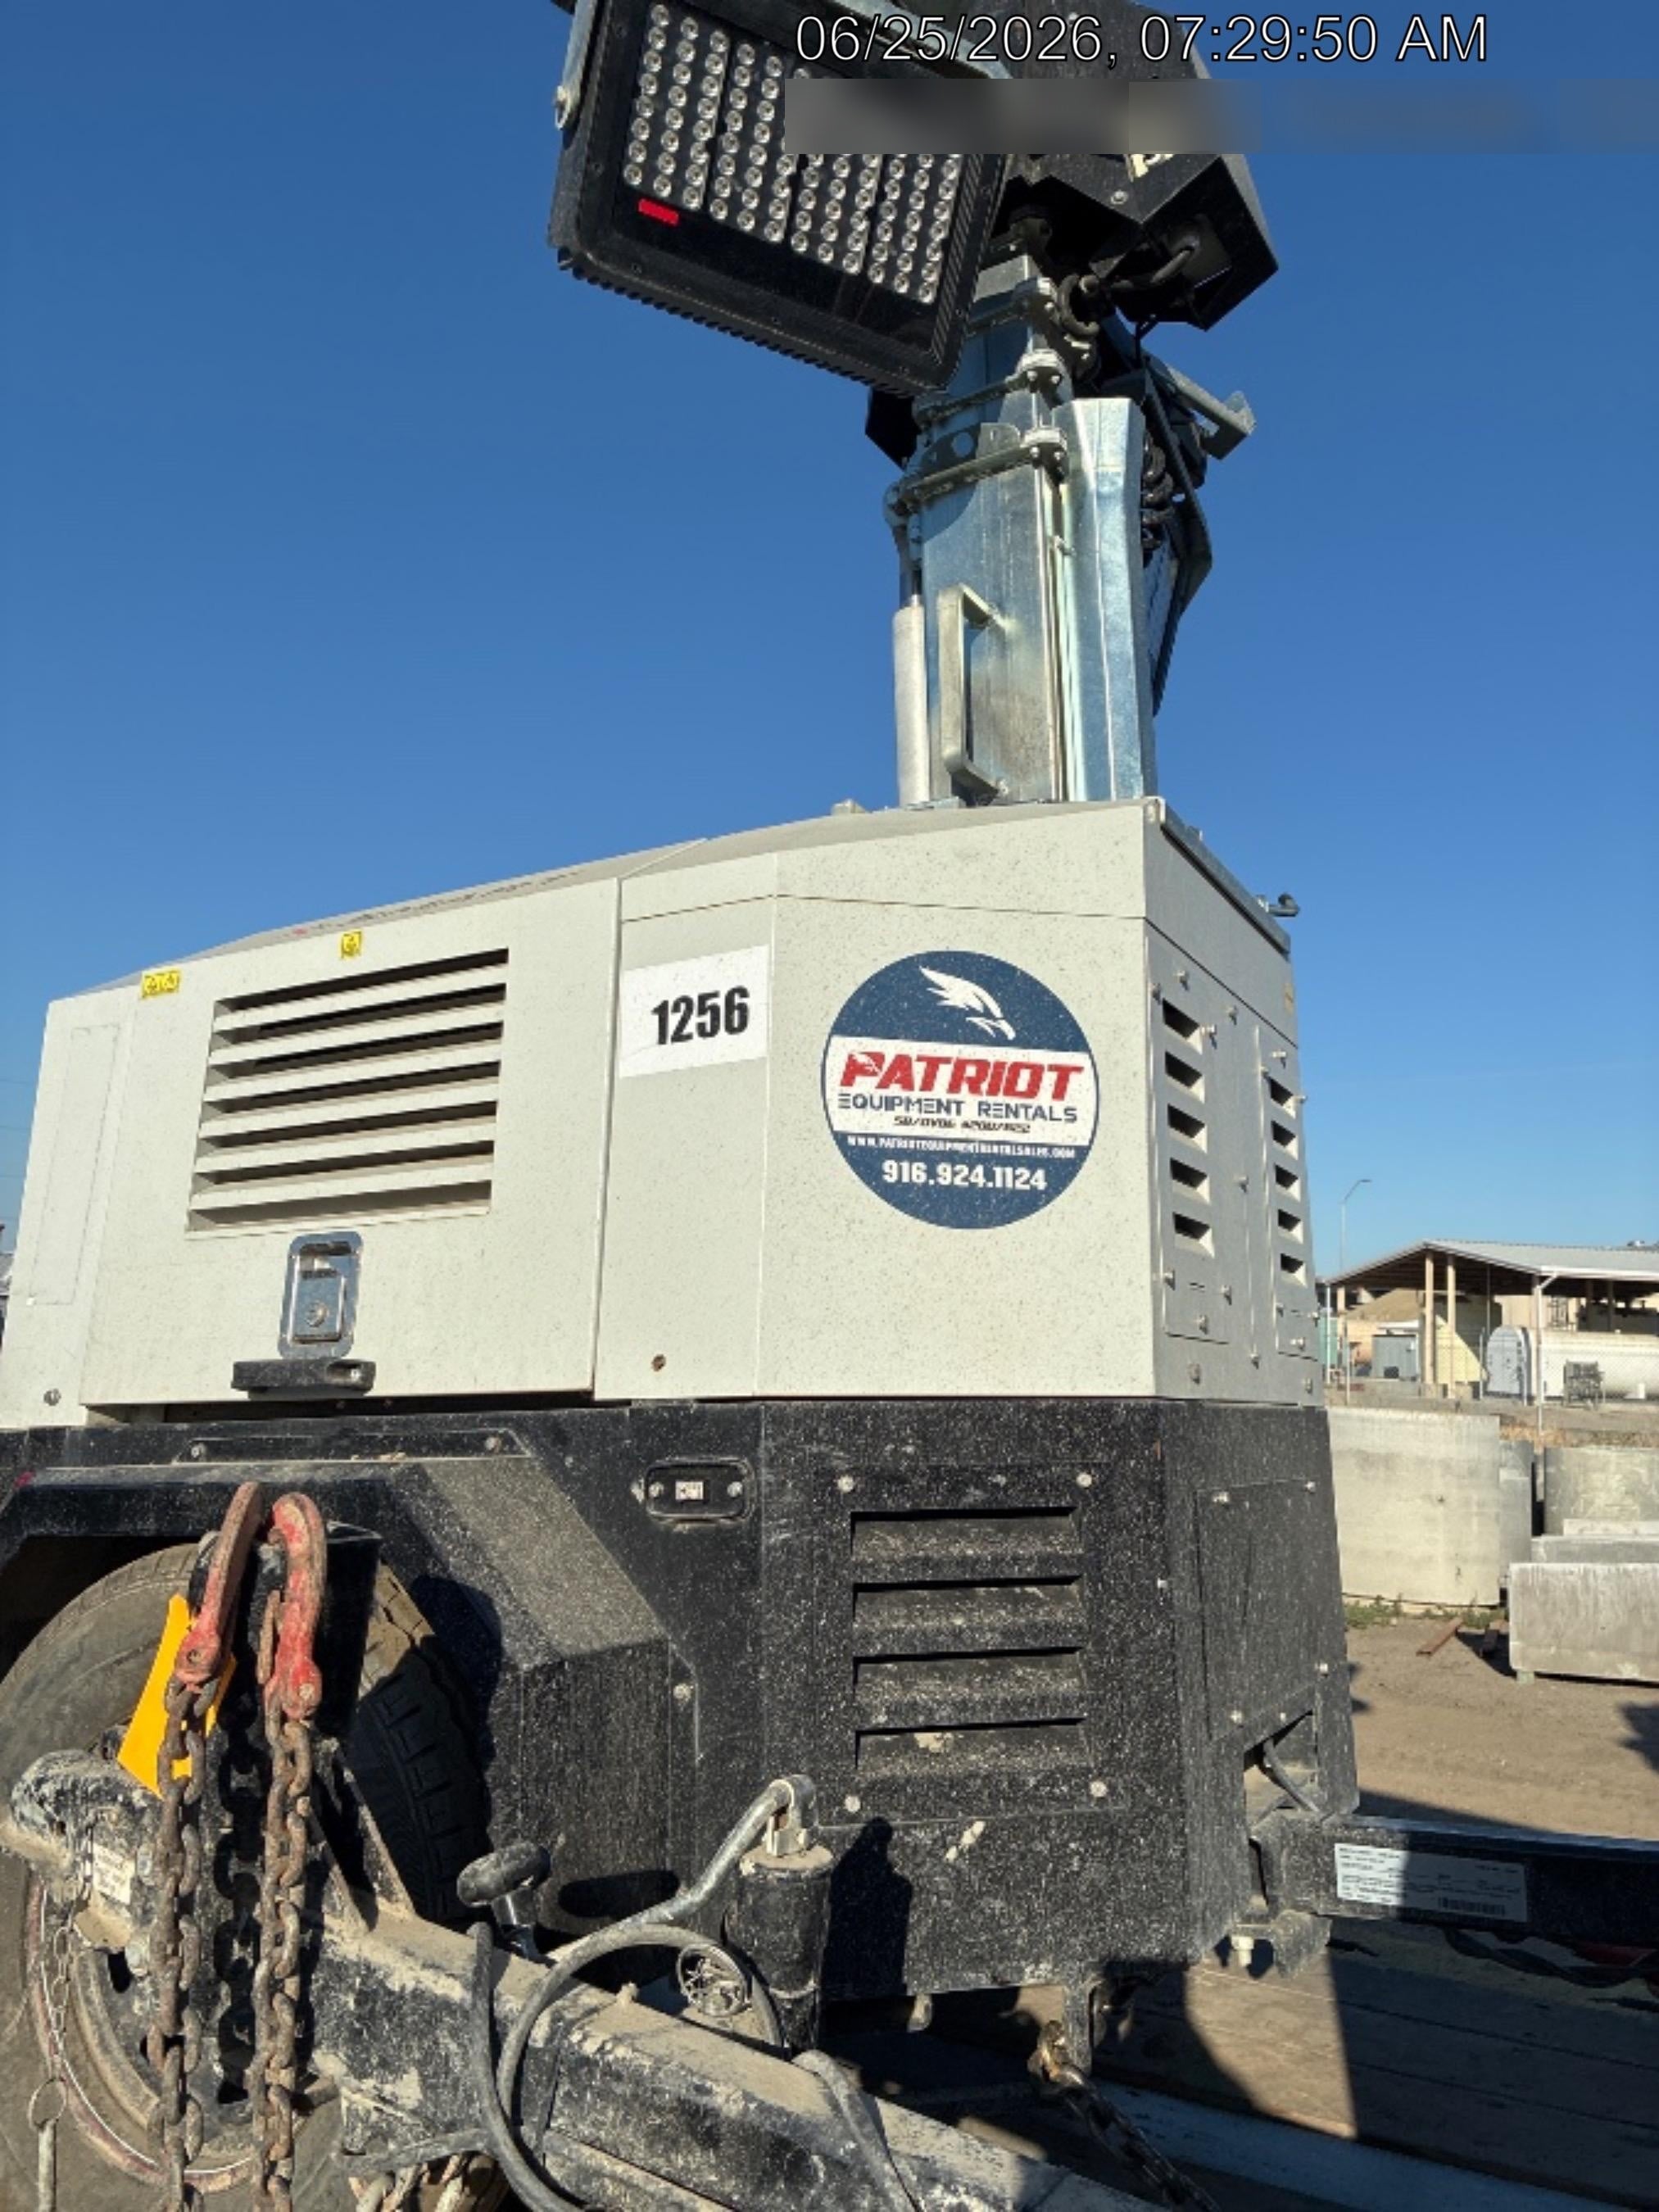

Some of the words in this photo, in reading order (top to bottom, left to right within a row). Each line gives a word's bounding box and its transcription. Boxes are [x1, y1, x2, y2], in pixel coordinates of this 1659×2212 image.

[651, 986, 750, 1045] 1256
[840, 1051, 1084, 1101] PATRIOT
[838, 1093, 965, 1117] EQUIPMENT
[977, 1100, 1077, 1123] RENTALS
[882, 1160, 1047, 1190] 916.924.1124
